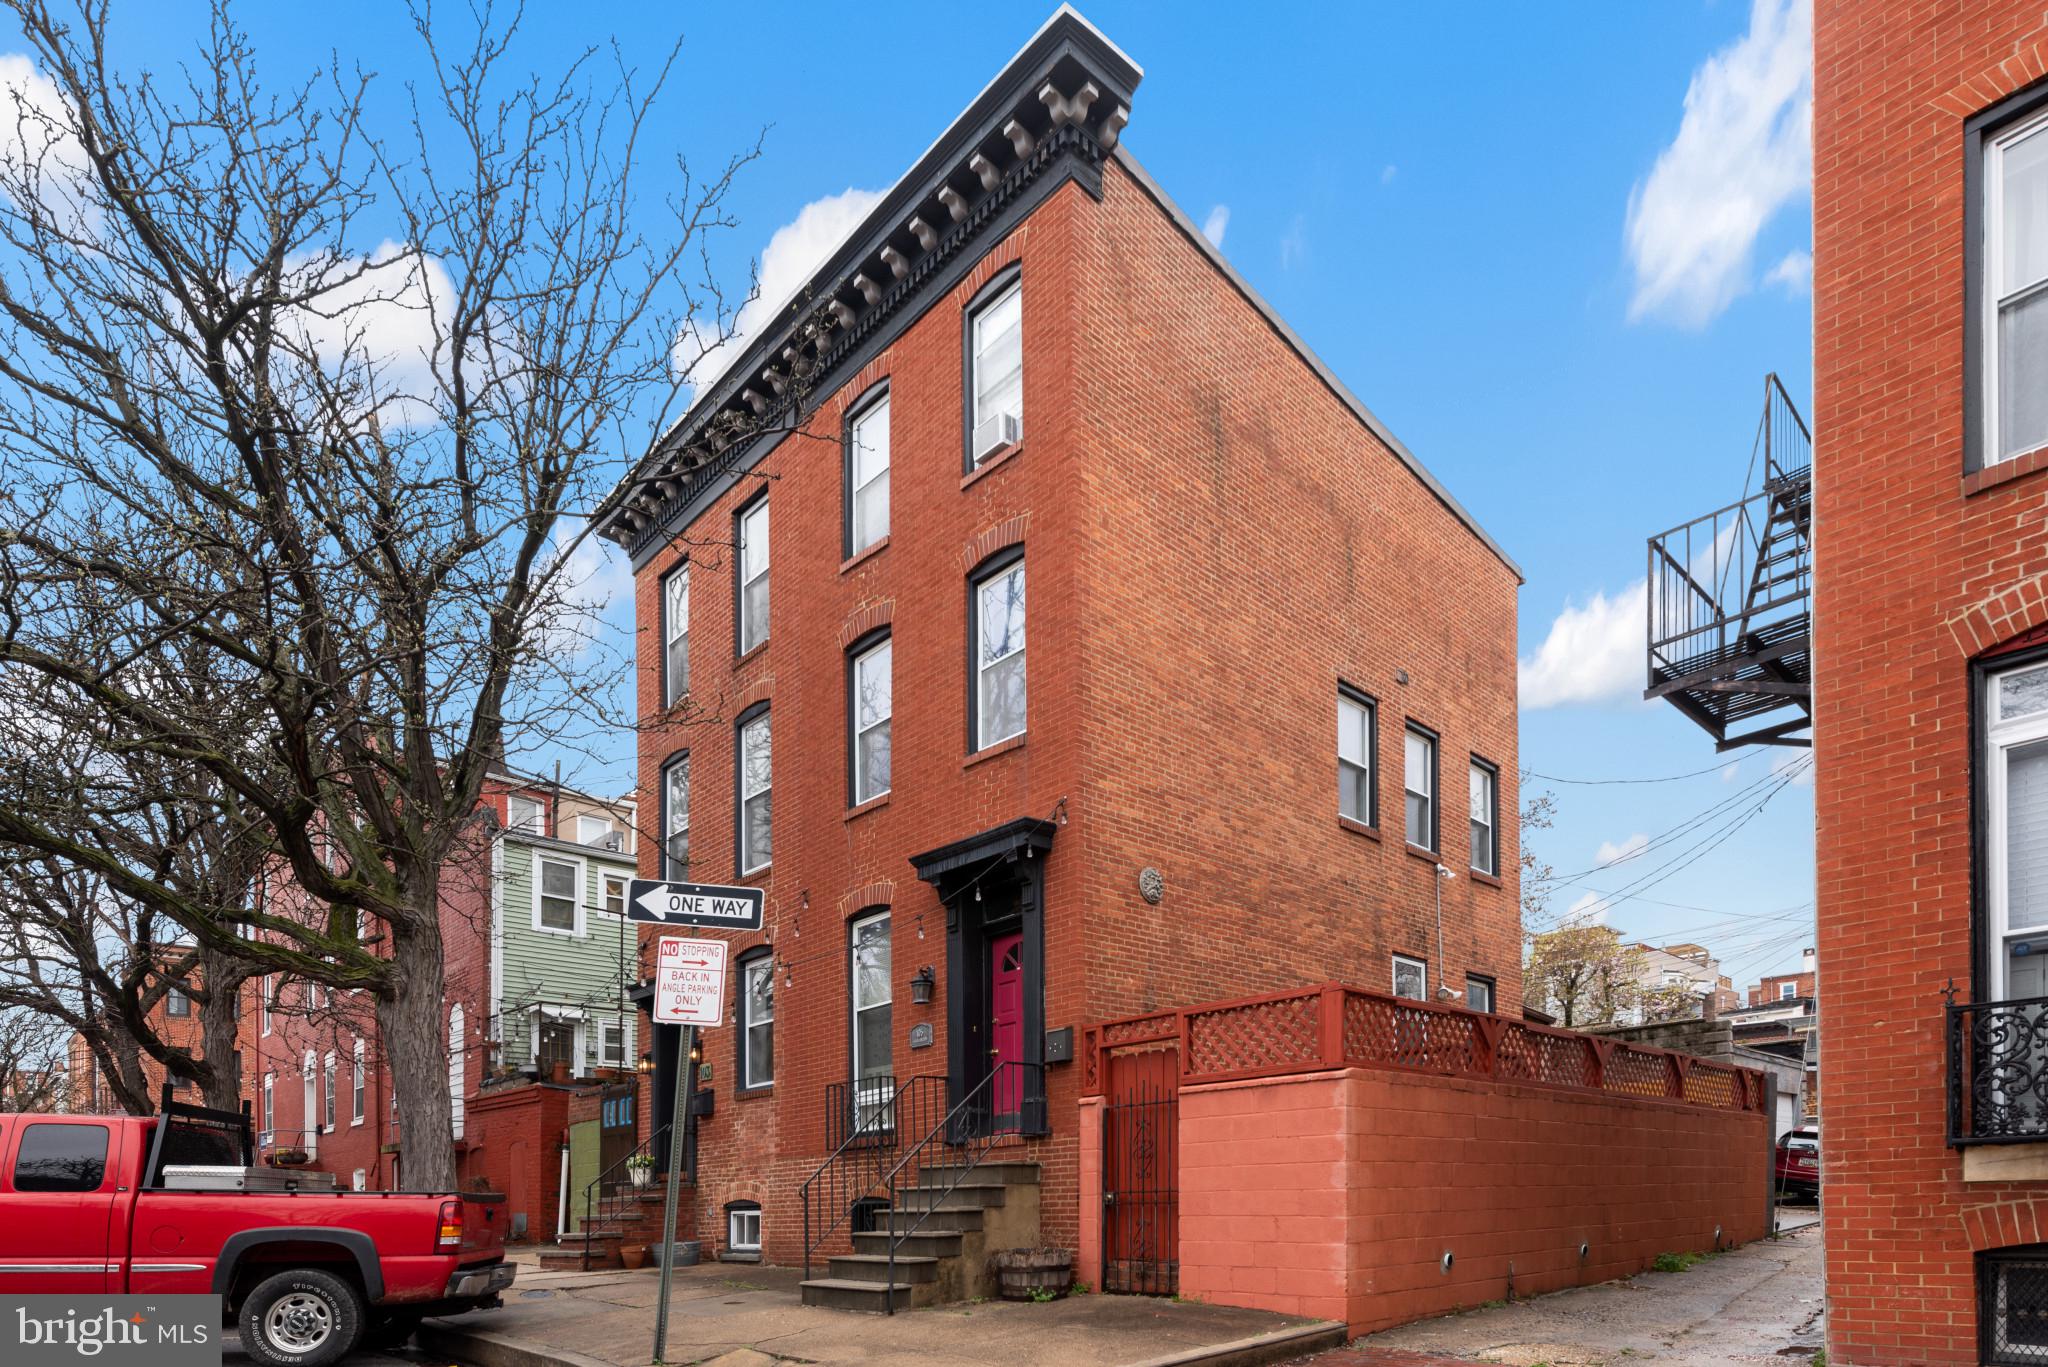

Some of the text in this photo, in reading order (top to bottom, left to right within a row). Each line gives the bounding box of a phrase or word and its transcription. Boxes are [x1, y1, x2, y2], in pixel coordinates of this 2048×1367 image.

[669, 895, 748, 916] ONE WAY
[662, 943, 720, 958] NO STOPPING
[671, 970, 710, 982] BACK IN
[661, 982, 718, 995] ANGLE PARKING
[675, 994, 703, 1006] ONLY
